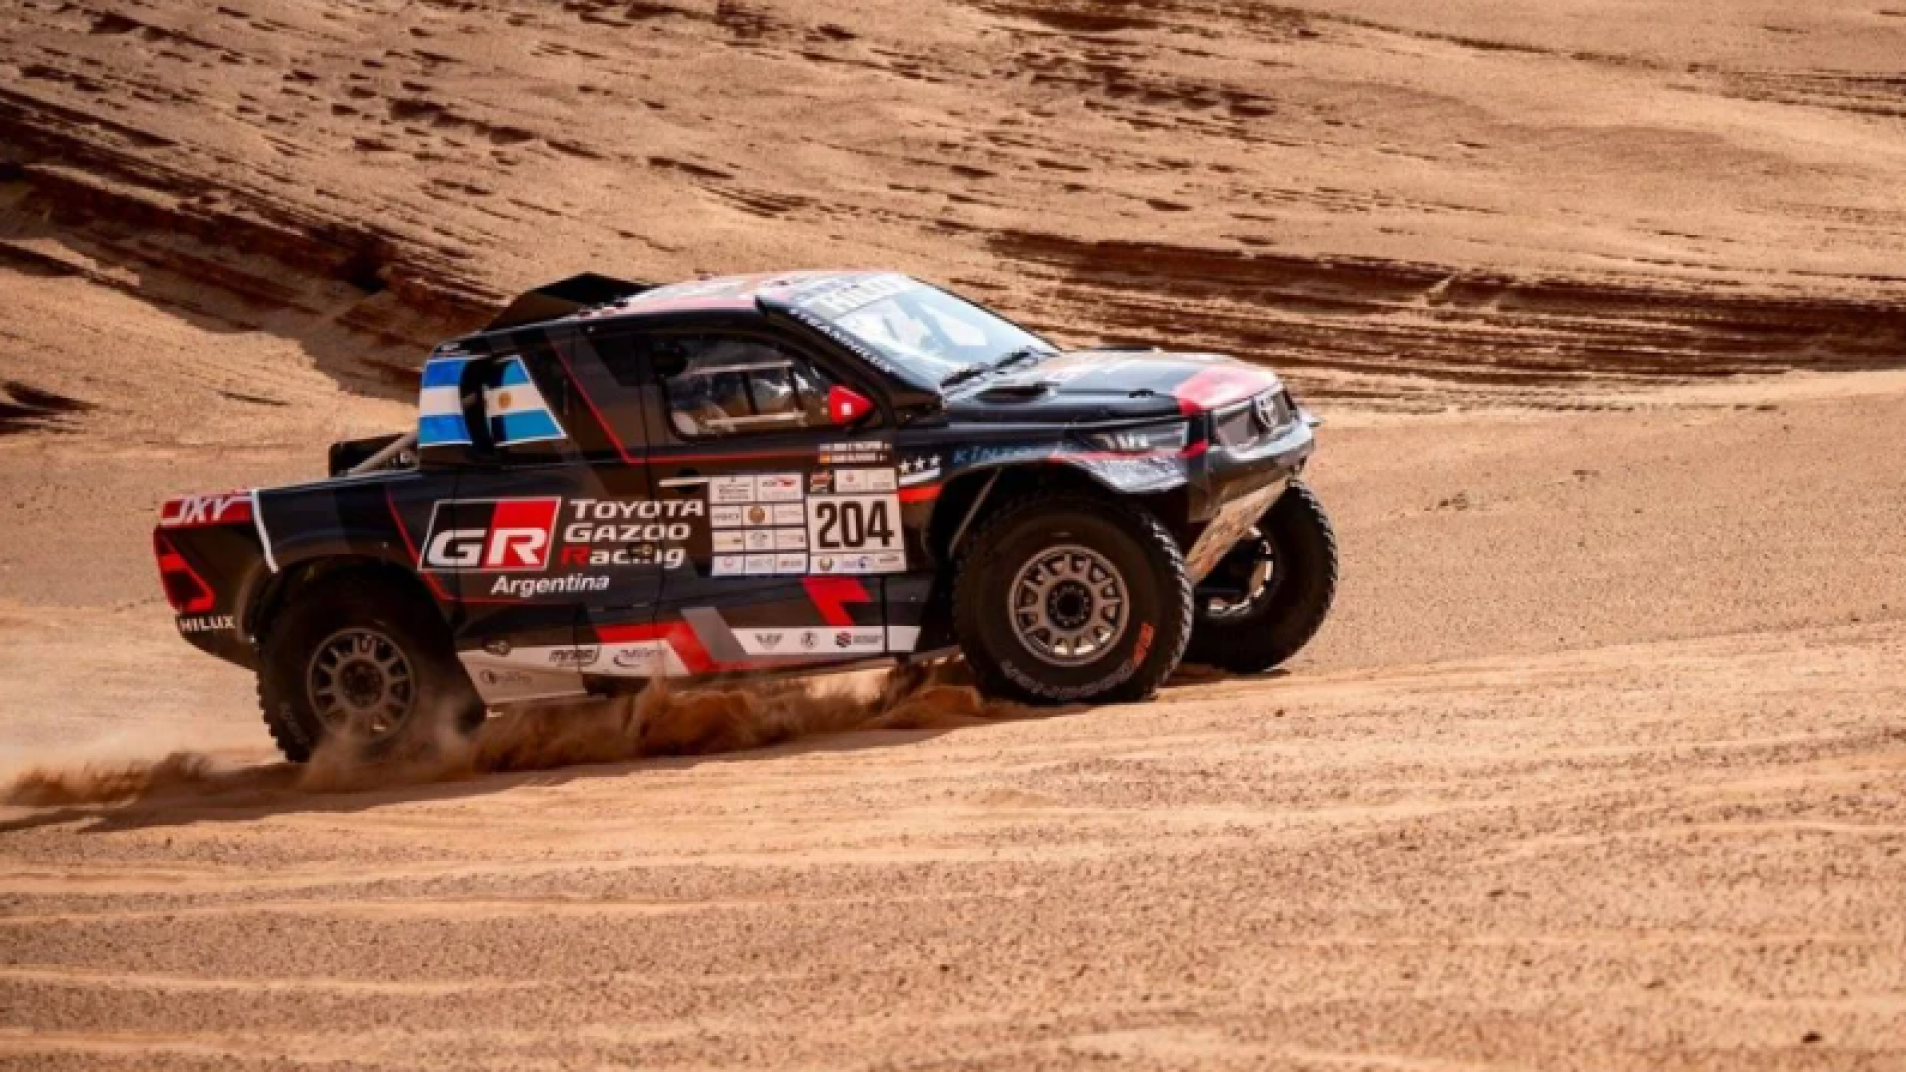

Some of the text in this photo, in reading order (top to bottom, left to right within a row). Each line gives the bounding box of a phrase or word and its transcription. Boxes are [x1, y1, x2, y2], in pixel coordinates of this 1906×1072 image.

[570, 498, 704, 520] TOYOTA
[562, 521, 691, 543] GAZOO
[816, 500, 895, 549] 204
[426, 528, 548, 567] GR
[491, 573, 610, 597] Argentina
[179, 614, 235, 632] HILUX
